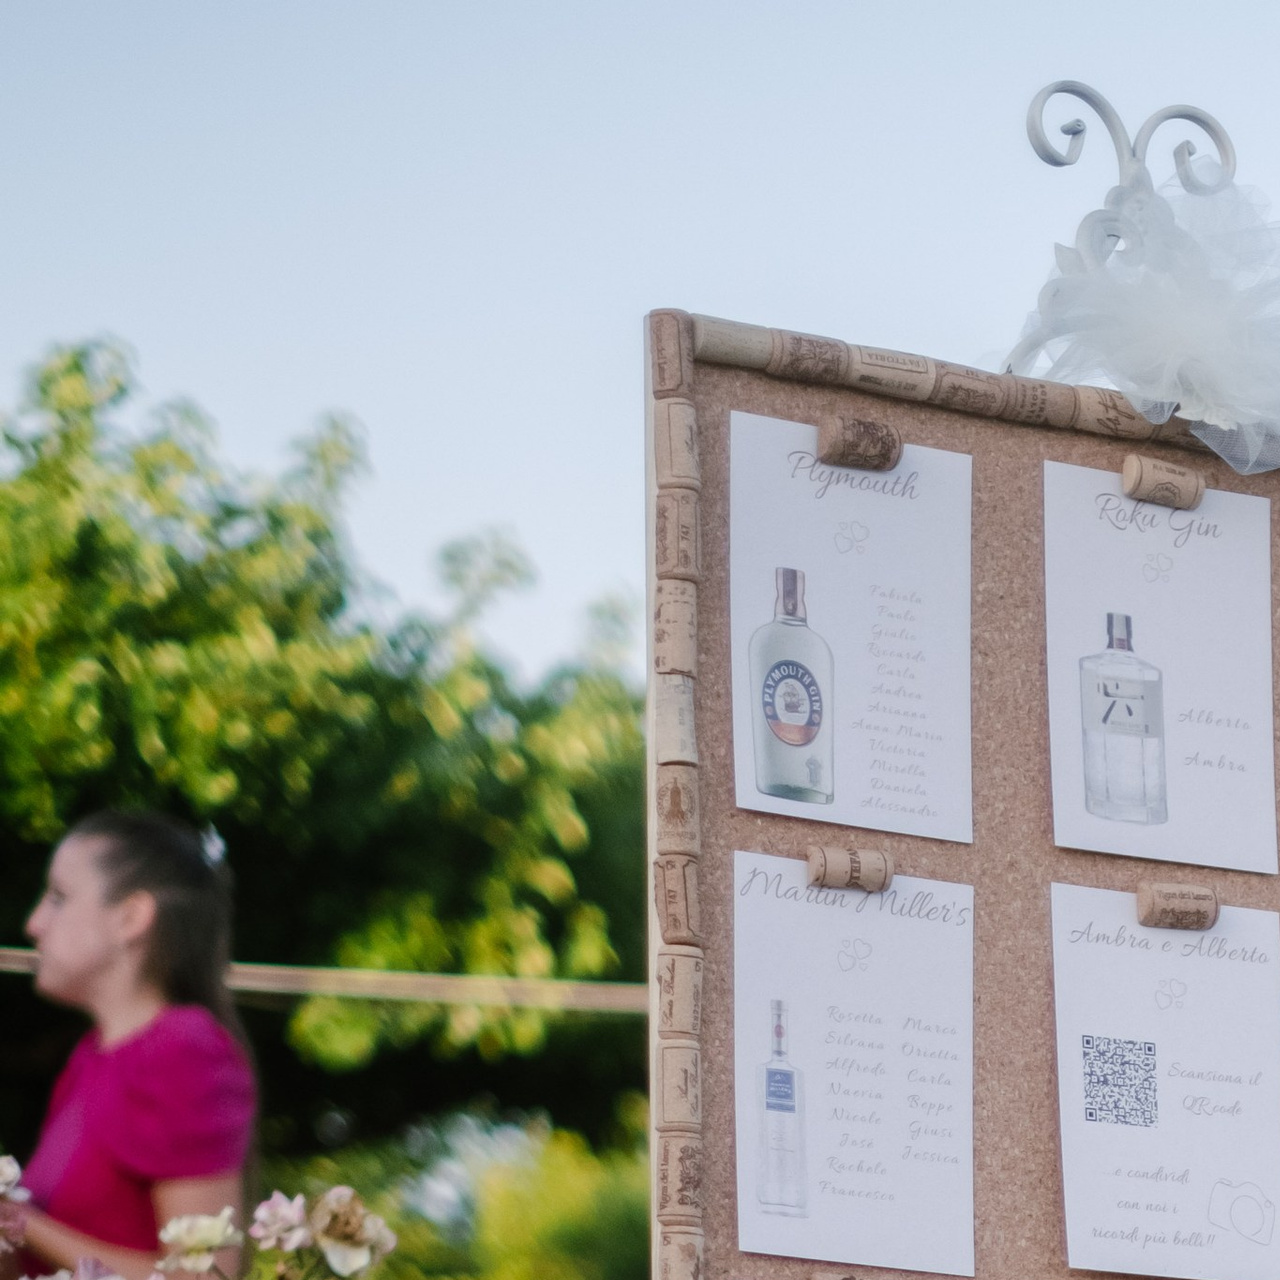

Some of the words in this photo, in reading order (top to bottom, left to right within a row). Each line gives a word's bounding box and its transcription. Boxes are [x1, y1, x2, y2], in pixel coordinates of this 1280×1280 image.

[787, 451, 920, 499] Plymouth
[1094, 493, 1159, 531] Roku
[1168, 508, 1222, 548] Gin
[680, 523, 691, 542] 747
[867, 642, 926, 661] Riccardo
[764, 665, 811, 702] PLYMOUTH
[809, 686, 821, 711] GIN
[871, 683, 922, 700] Andrea
[867, 702, 926, 719] Arianna
[1178, 708, 1251, 730] Alberto
[1184, 751, 1246, 772] Ambra
[860, 796, 938, 817] Alessandro
[667, 889, 678, 906] 747
[740, 866, 851, 909] Martin
[855, 887, 971, 927] Miller's
[1068, 921, 1154, 950] Ambra
[1161, 940, 1174, 952] e
[1181, 934, 1270, 964] Alberto
[826, 1005, 884, 1025] Rosetta
[902, 1017, 957, 1036] Marco
[824, 1031, 885, 1050] Silvana
[825, 1057, 886, 1077] Alfredo
[1167, 1061, 1243, 1085] Scansiona
[1249, 1071, 1263, 1086] il
[907, 1069, 952, 1086] Carla
[907, 1094, 953, 1116] Beppe
[828, 1107, 882, 1125] Nicole
[908, 1120, 953, 1141] Giusi
[902, 1145, 959, 1164] Jessica
[826, 1156, 887, 1176] Rachele
[1127, 1166, 1191, 1185] condividi
[819, 1180, 895, 1201] Francesco
[1117, 1200, 1141, 1210] con
[1146, 1202, 1168, 1213] noi
[1172, 1203, 1179, 1214] i
[1092, 1227, 1140, 1242] ricordi
[1143, 1231, 1168, 1250] più
